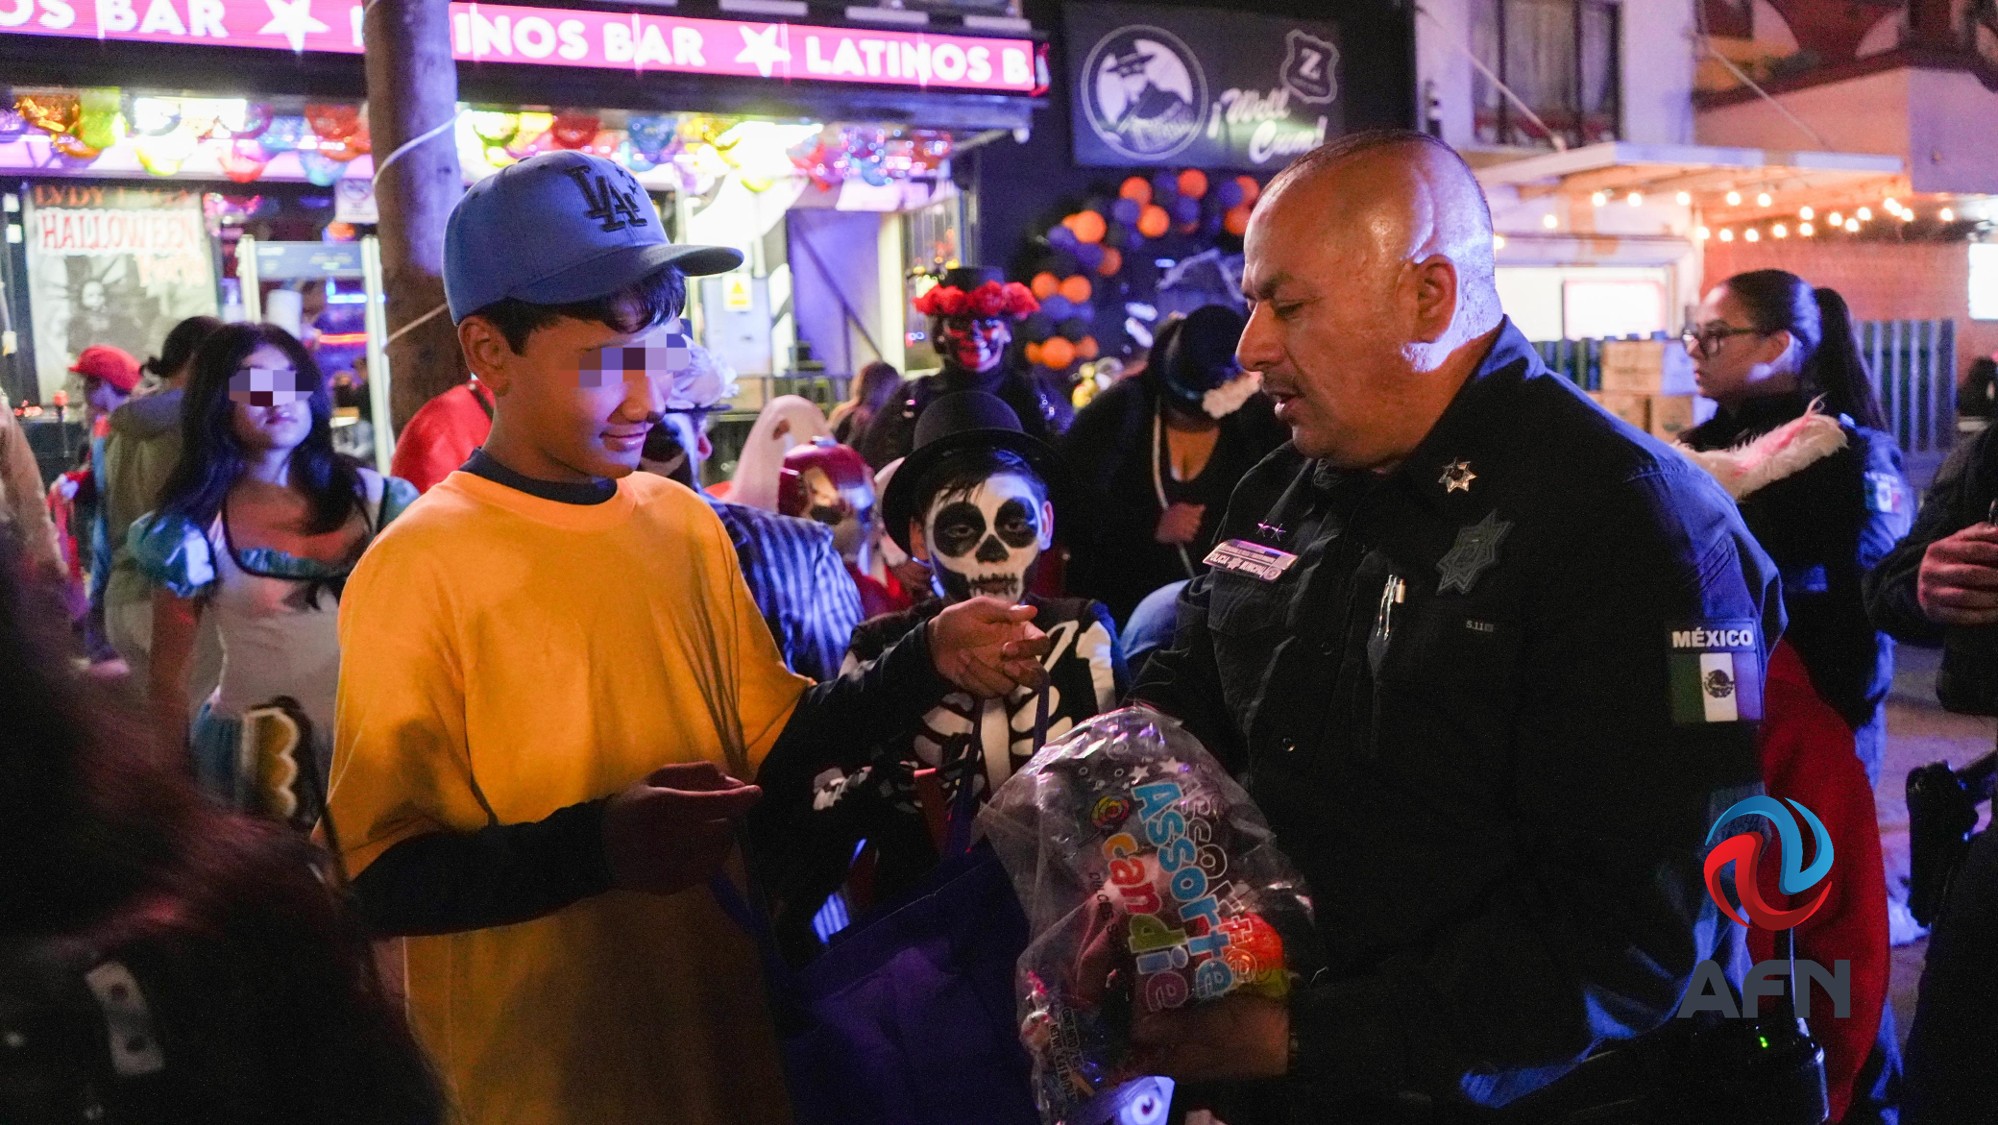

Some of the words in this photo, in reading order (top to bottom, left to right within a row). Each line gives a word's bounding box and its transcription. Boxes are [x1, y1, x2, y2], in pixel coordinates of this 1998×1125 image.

[103, 0, 229, 37] BAR
[602, 22, 706, 67] BAR
[805, 36, 993, 83] LATINOS
[1300, 48, 1321, 79] Z
[563, 165, 648, 233] LA
[42, 213, 197, 250] HALLOWEEN
[1672, 626, 1753, 648] MÉXICO
